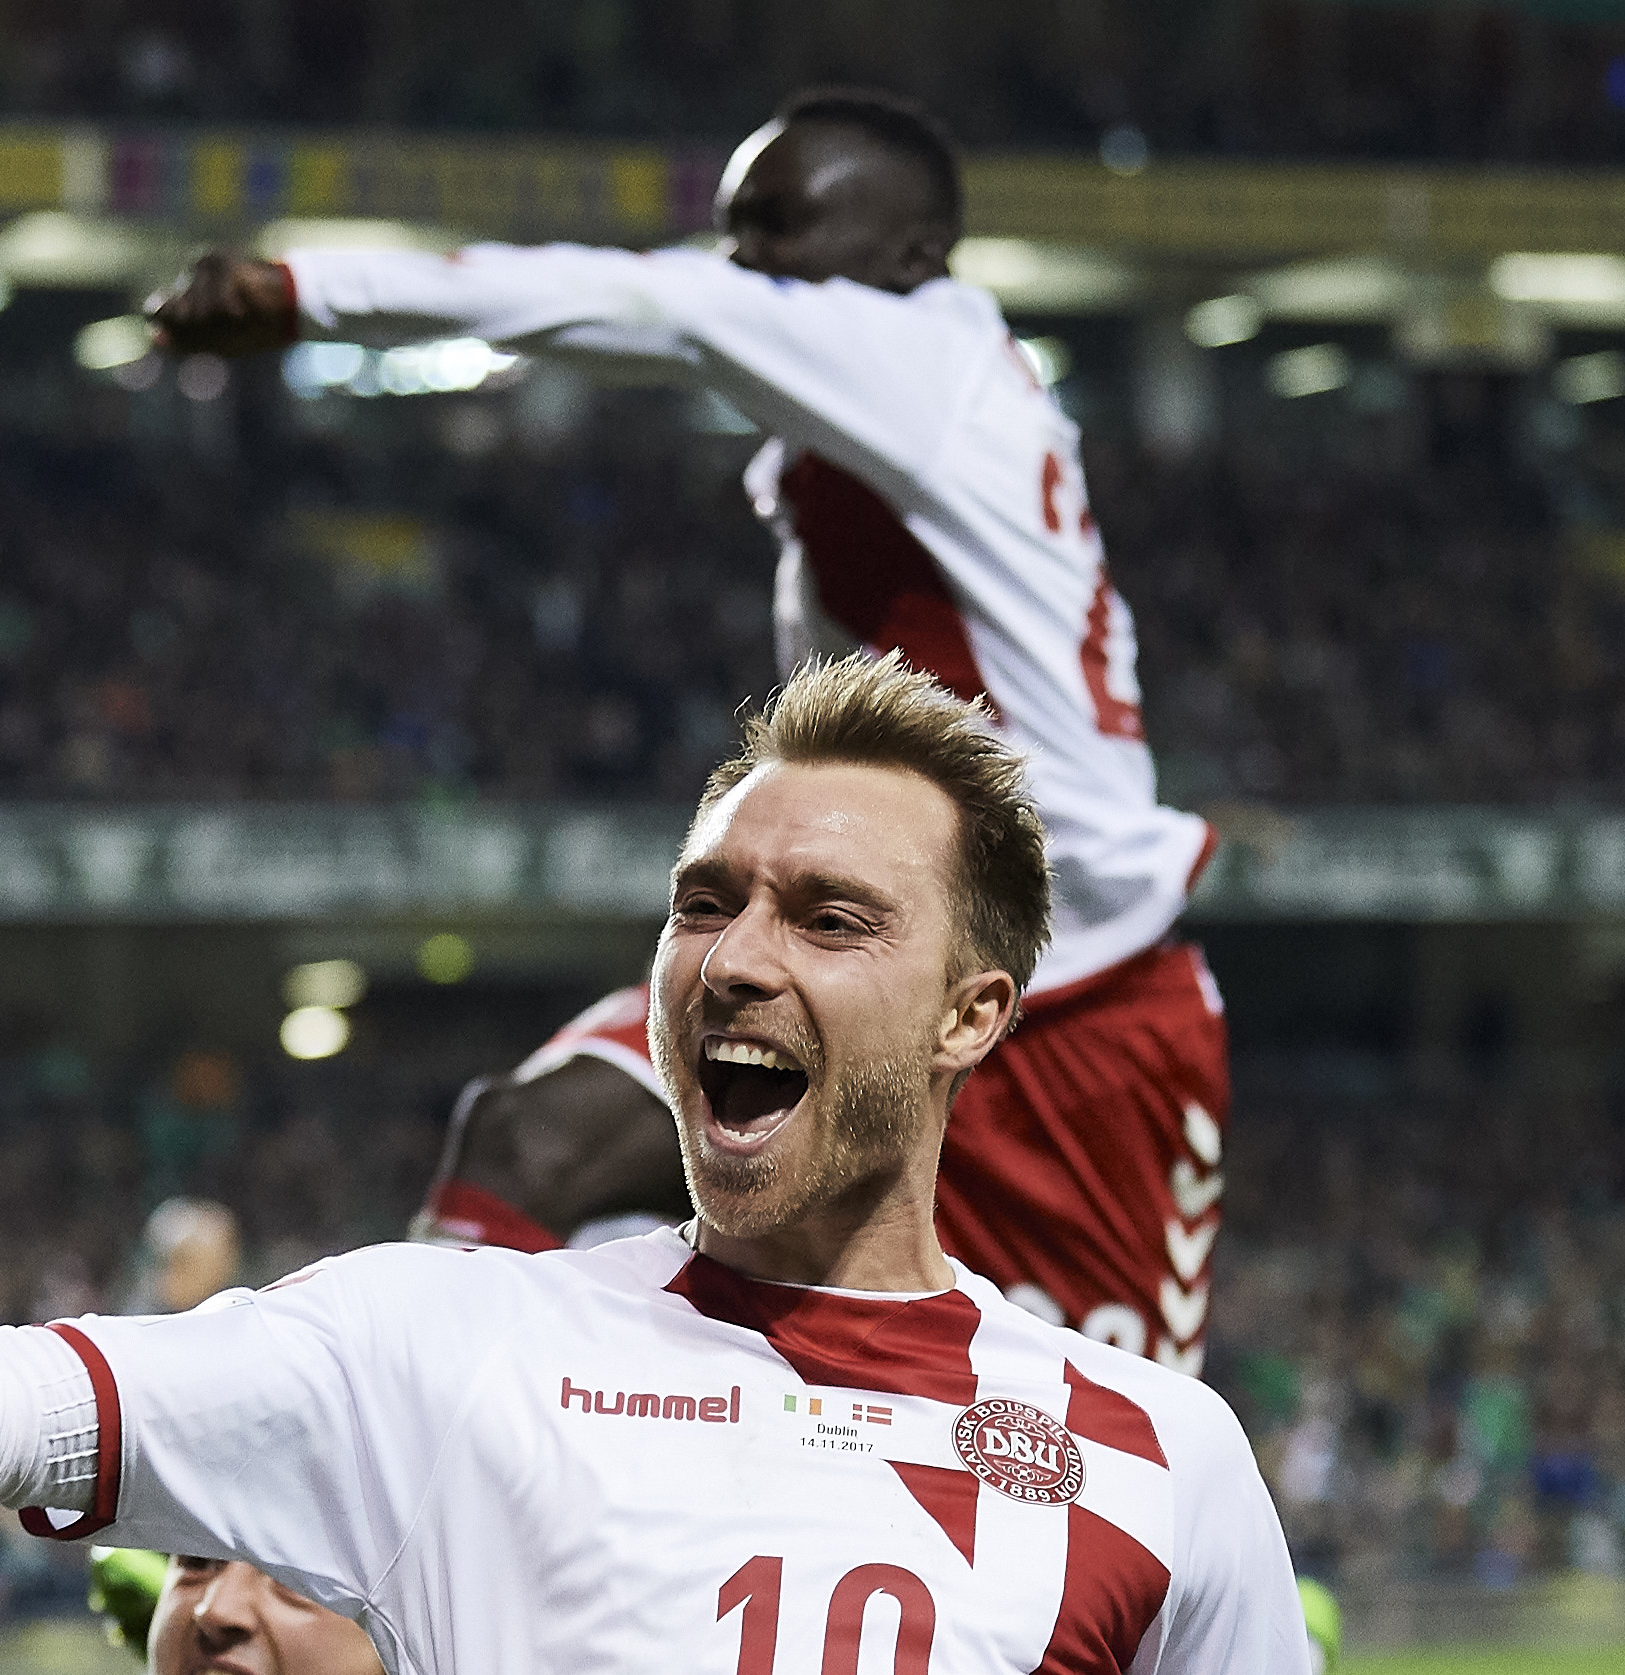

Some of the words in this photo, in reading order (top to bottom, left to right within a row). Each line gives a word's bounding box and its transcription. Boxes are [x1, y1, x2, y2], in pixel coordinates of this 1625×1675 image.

[561, 1377, 741, 1424] hummel
[800, 1437, 874, 1453] 14.11.2017
[817, 1423, 858, 1437] Dublin
[957, 1417, 991, 1478] DANSK
[982, 1427, 1061, 1474] DBU
[998, 1479, 1051, 1502] 1889
